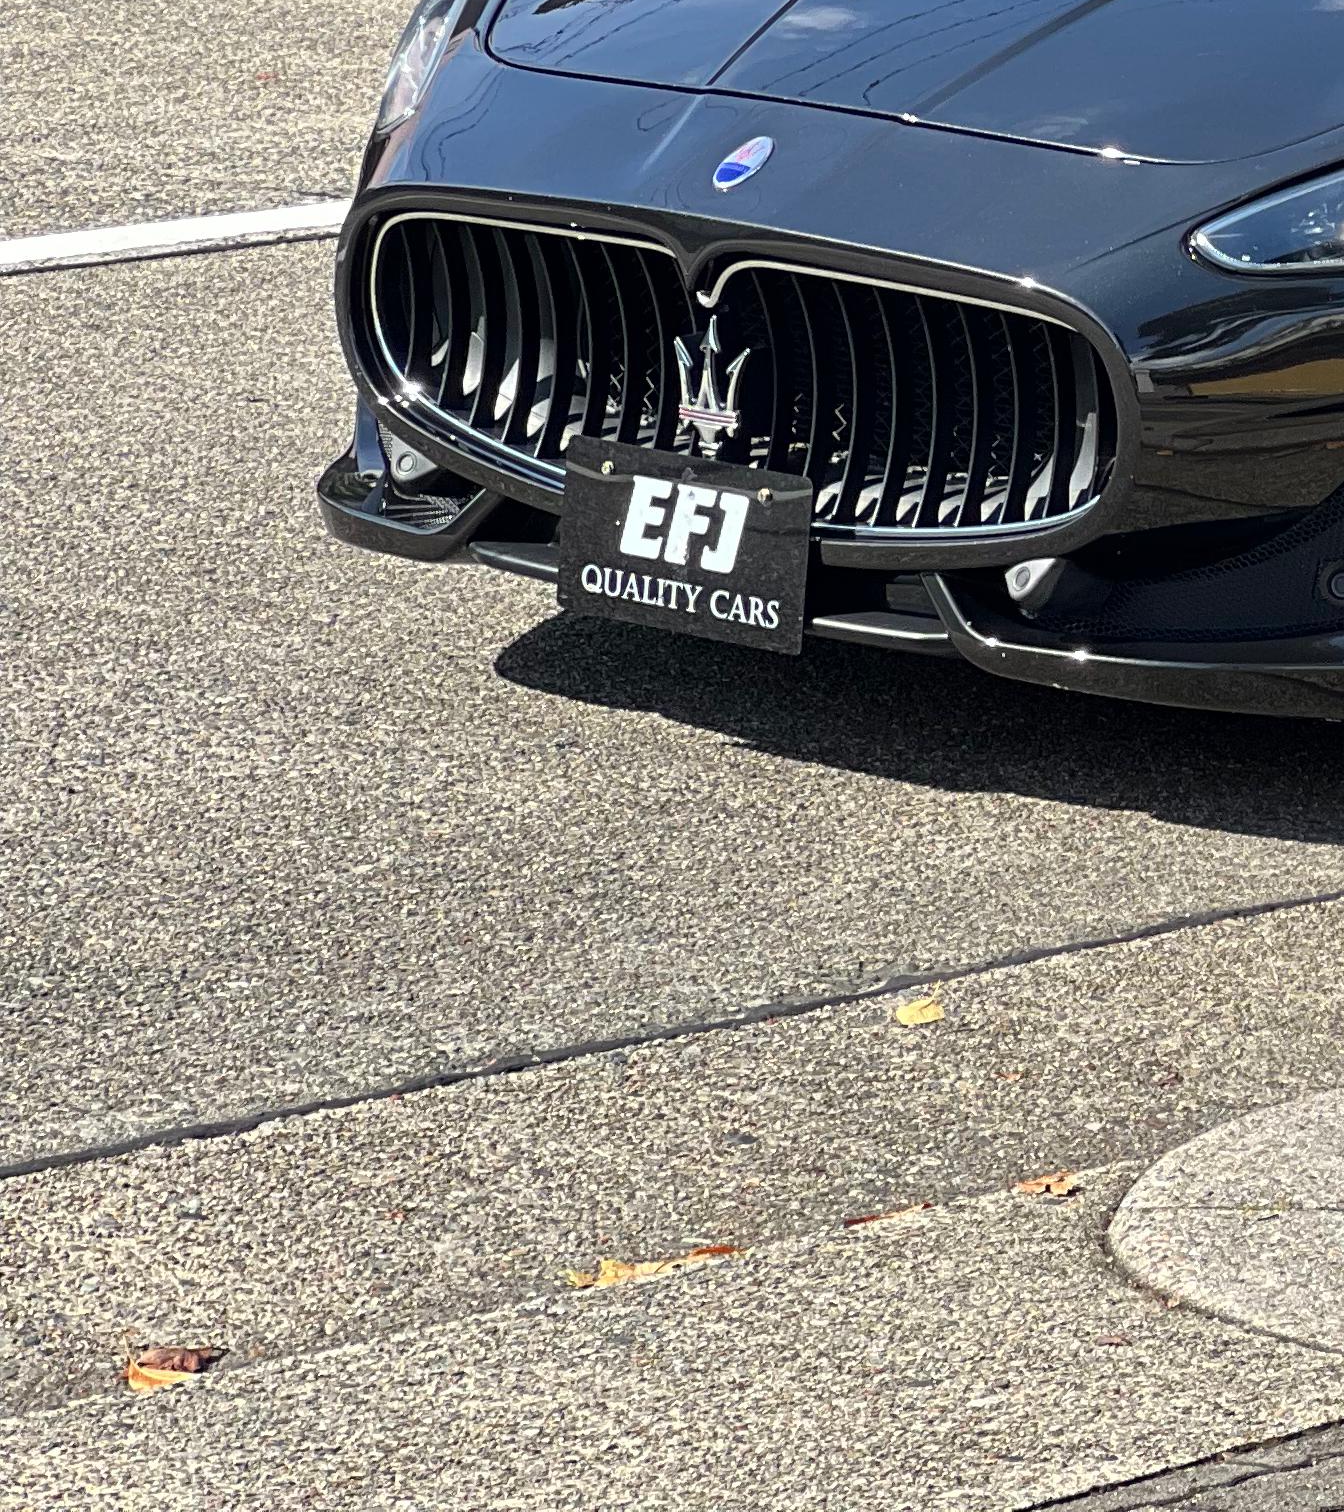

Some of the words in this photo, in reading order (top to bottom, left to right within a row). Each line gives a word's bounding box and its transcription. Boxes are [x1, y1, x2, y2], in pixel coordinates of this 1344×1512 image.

[620, 475, 750, 574] EFJ
[581, 564, 703, 613] QUALITY
[710, 589, 781, 629] CARS
